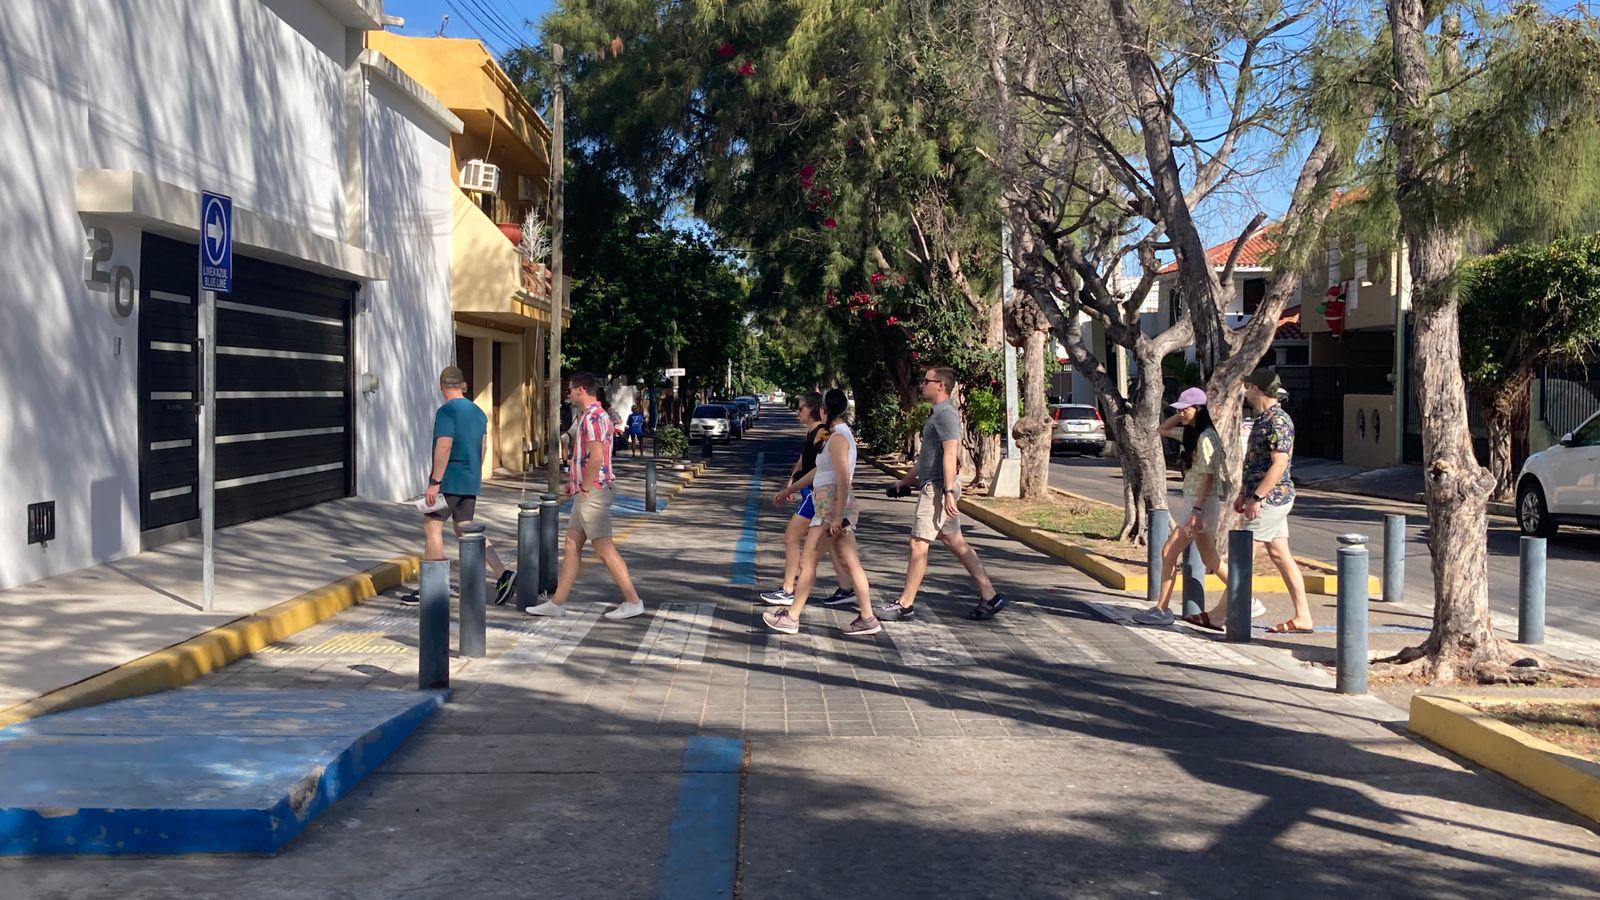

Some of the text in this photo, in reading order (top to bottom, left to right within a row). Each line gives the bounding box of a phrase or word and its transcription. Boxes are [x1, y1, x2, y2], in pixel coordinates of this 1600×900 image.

[85, 228, 134, 318] 20
[216, 268, 228, 278] AZUL
[205, 276, 227, 288] BLUE LINE
